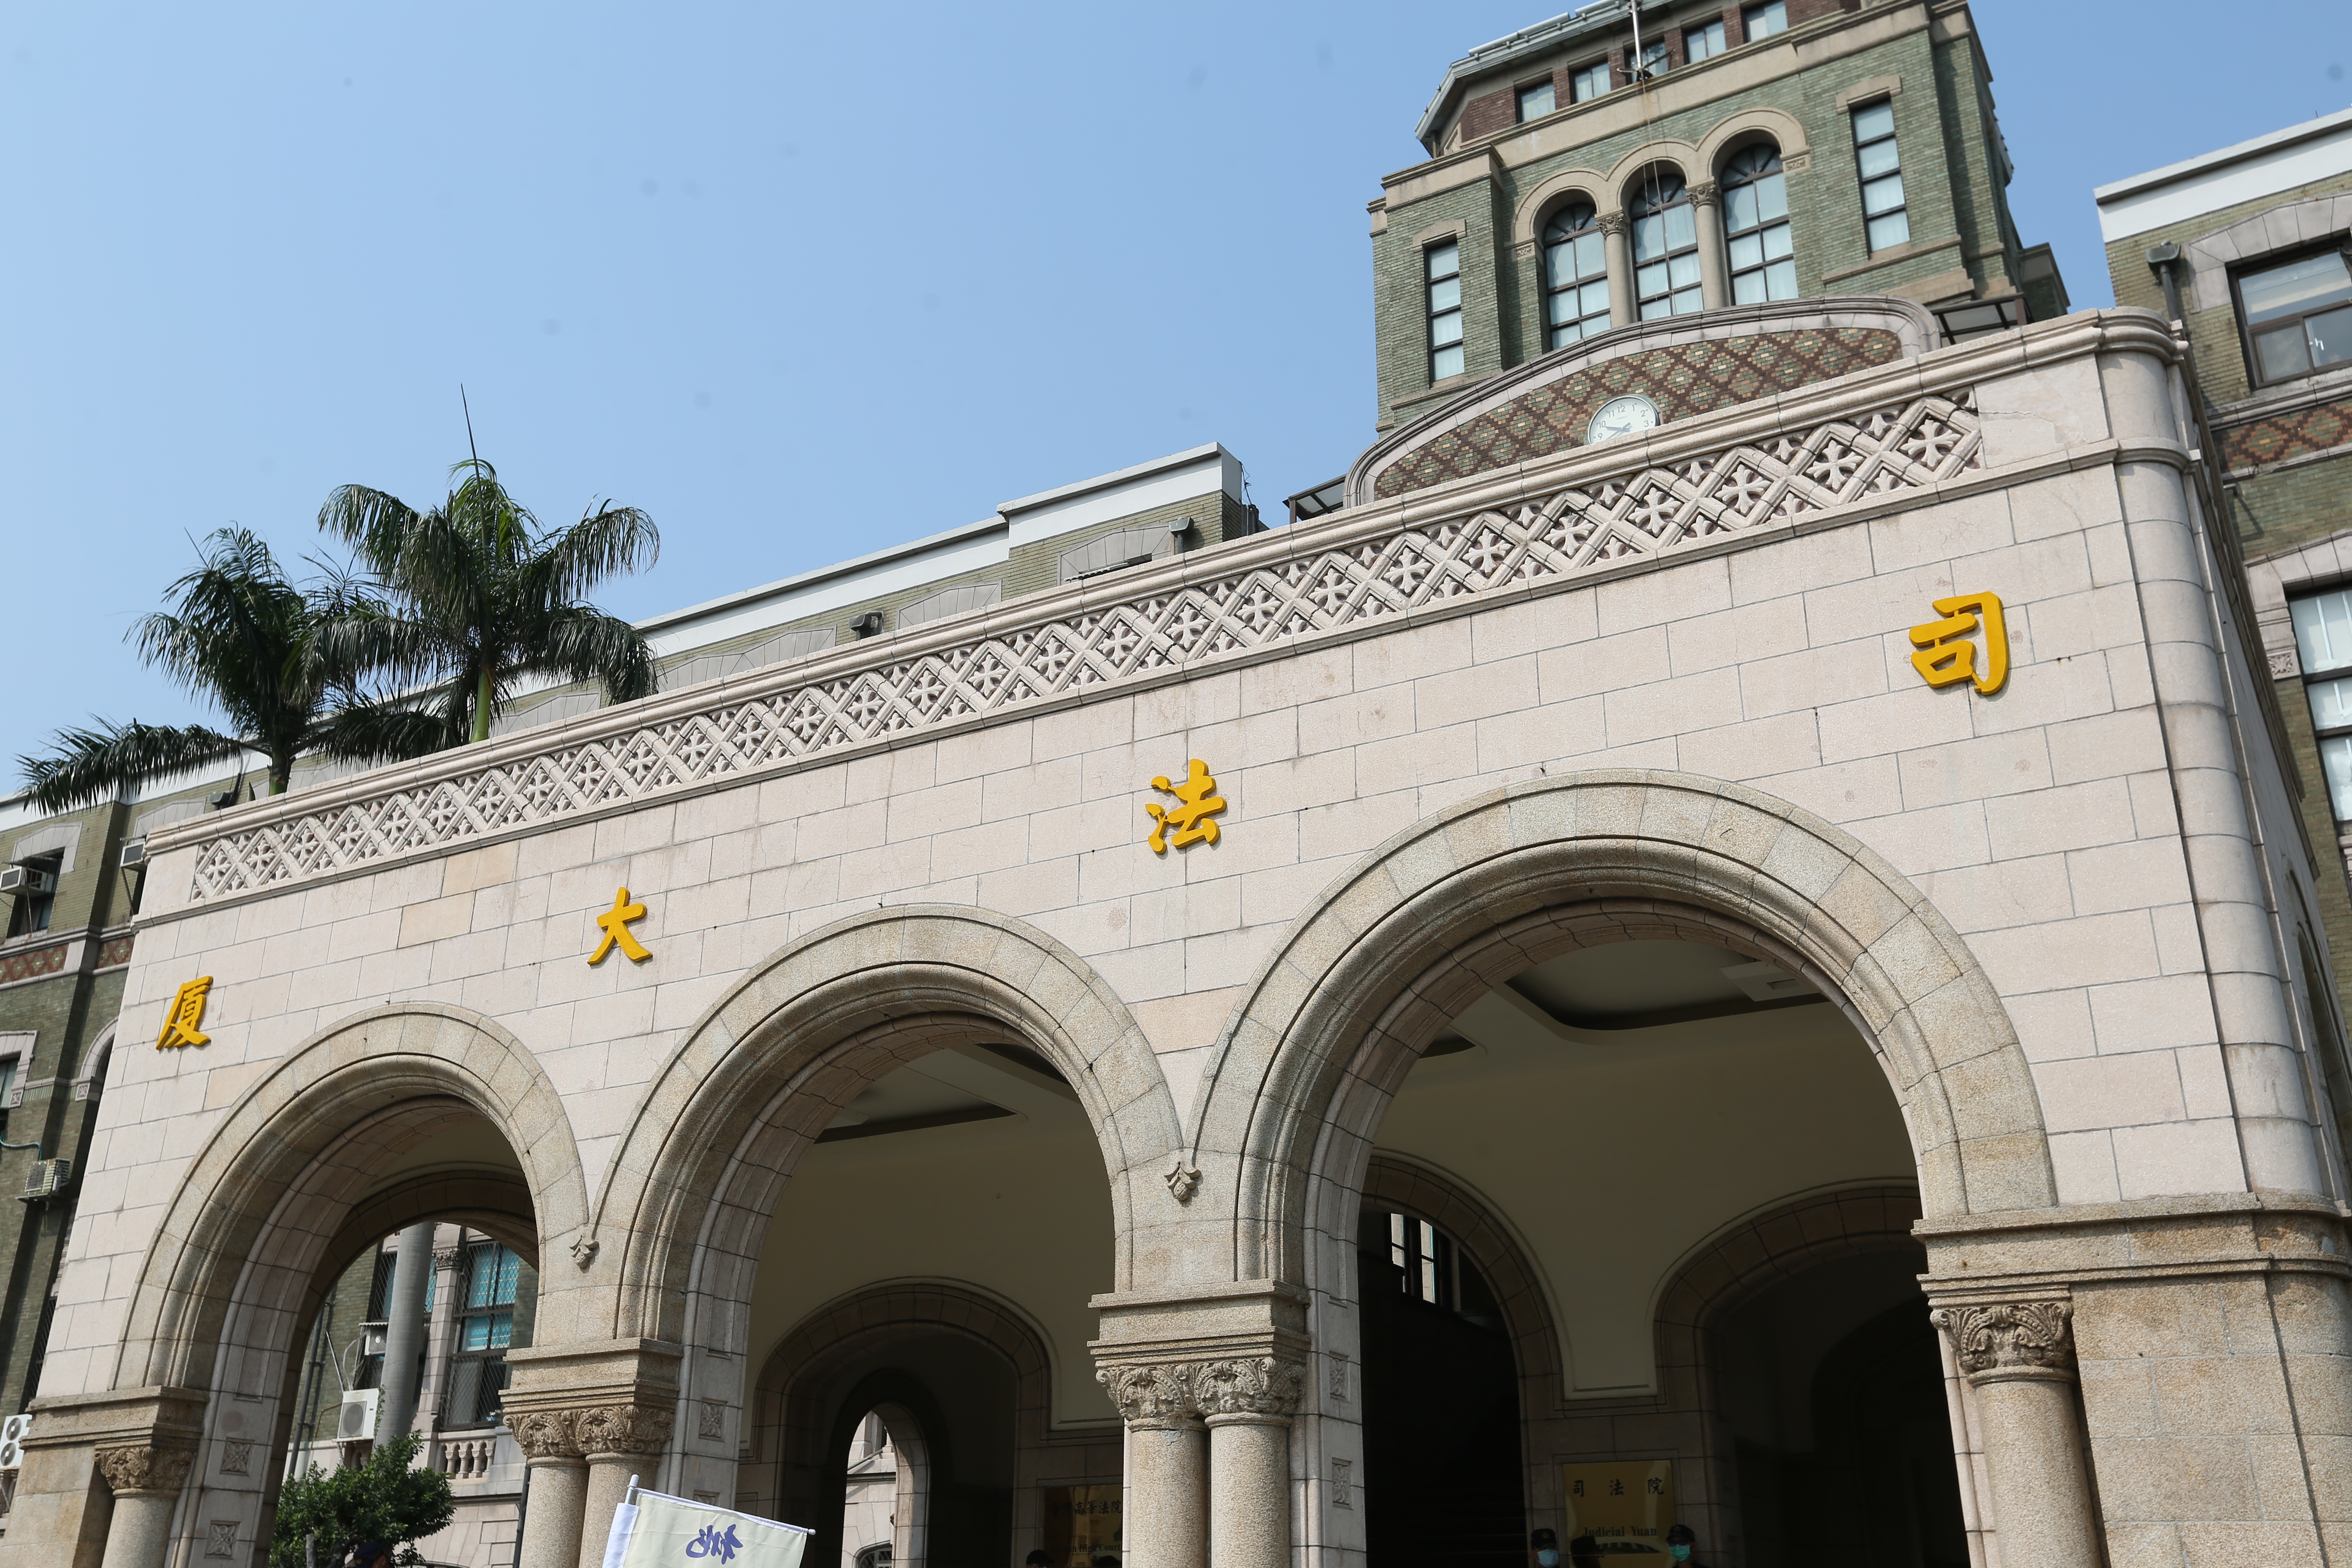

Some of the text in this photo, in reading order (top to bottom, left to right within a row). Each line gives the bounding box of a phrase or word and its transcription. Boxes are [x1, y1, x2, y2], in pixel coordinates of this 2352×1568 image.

[1617, 405, 1626, 413] 12
[1598, 420, 1606, 428] 10
[1909, 591, 2009, 696] 司
[1145, 759, 1227, 855] 法
[588, 887, 653, 965] 大
[1572, 1477, 1664, 1497] 司法院
[1582, 1526, 1657, 1537] Judicial Yuan
[1099, 1543, 1121, 1551] Court
